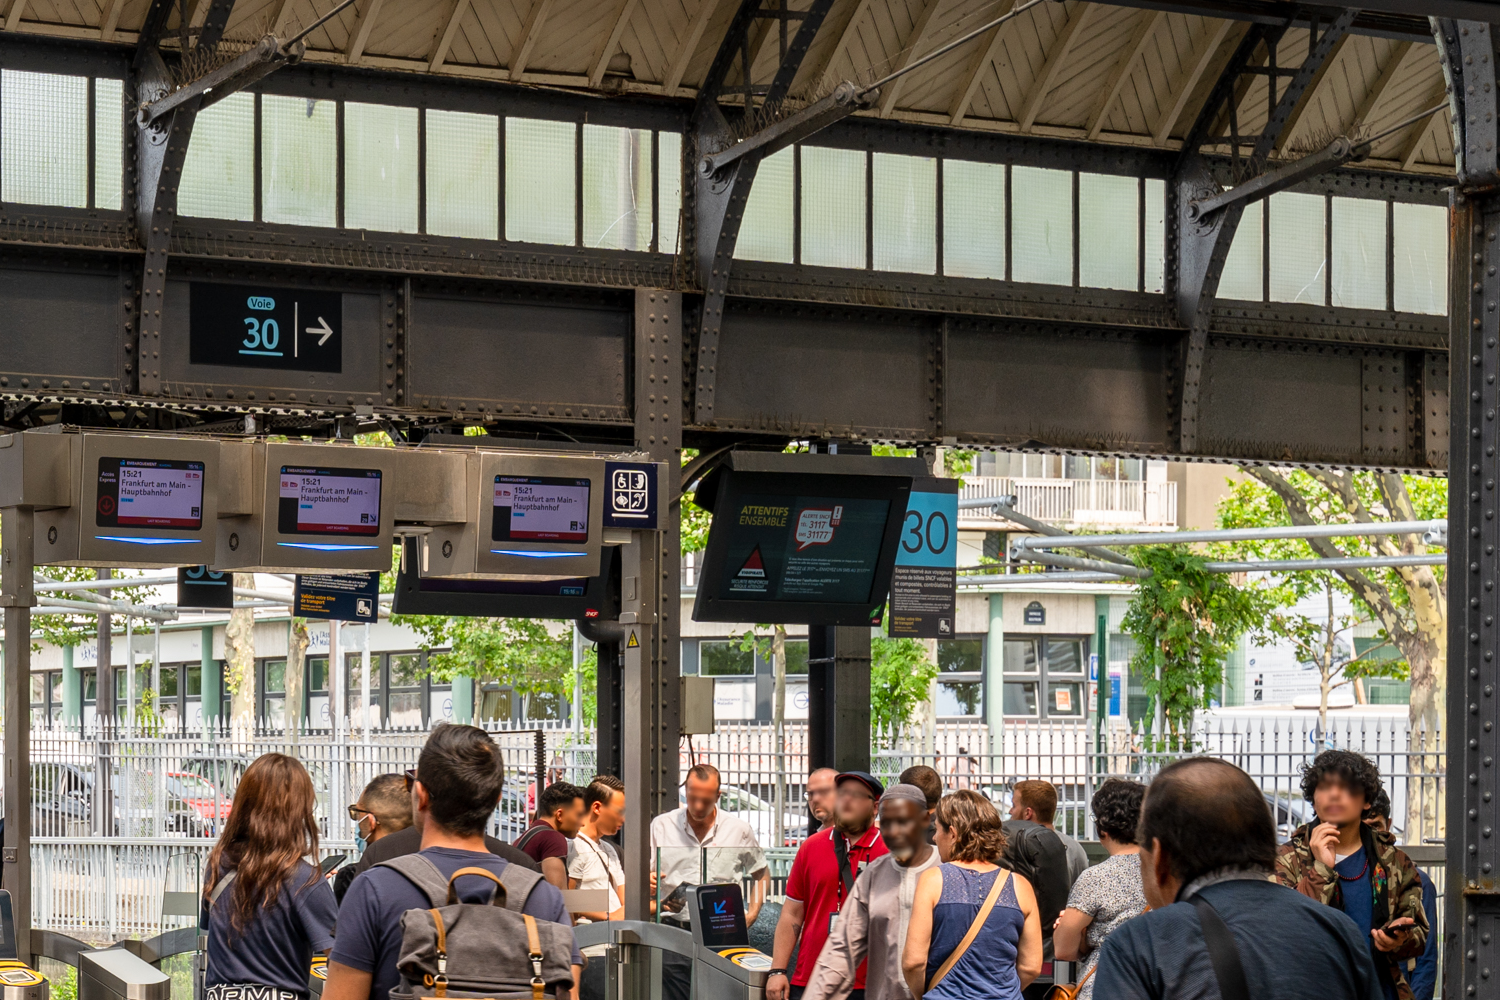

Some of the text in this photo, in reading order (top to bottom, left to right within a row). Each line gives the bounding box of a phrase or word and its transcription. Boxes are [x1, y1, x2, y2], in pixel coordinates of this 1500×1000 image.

[250, 298, 271, 308] Voie
[242, 317, 280, 350] 30
[122, 479, 155, 487] Frankfurt
[121, 488, 172, 497] Hauptbahnhof
[301, 486, 333, 494] Frankfurt
[300, 494, 349, 503] Hauptbahnhof
[513, 503, 560, 511] Hauptbahnhof
[741, 505, 789, 516] ATTENTIFS
[739, 516, 787, 527] ENSEMBLE
[902, 510, 949, 554] 30
